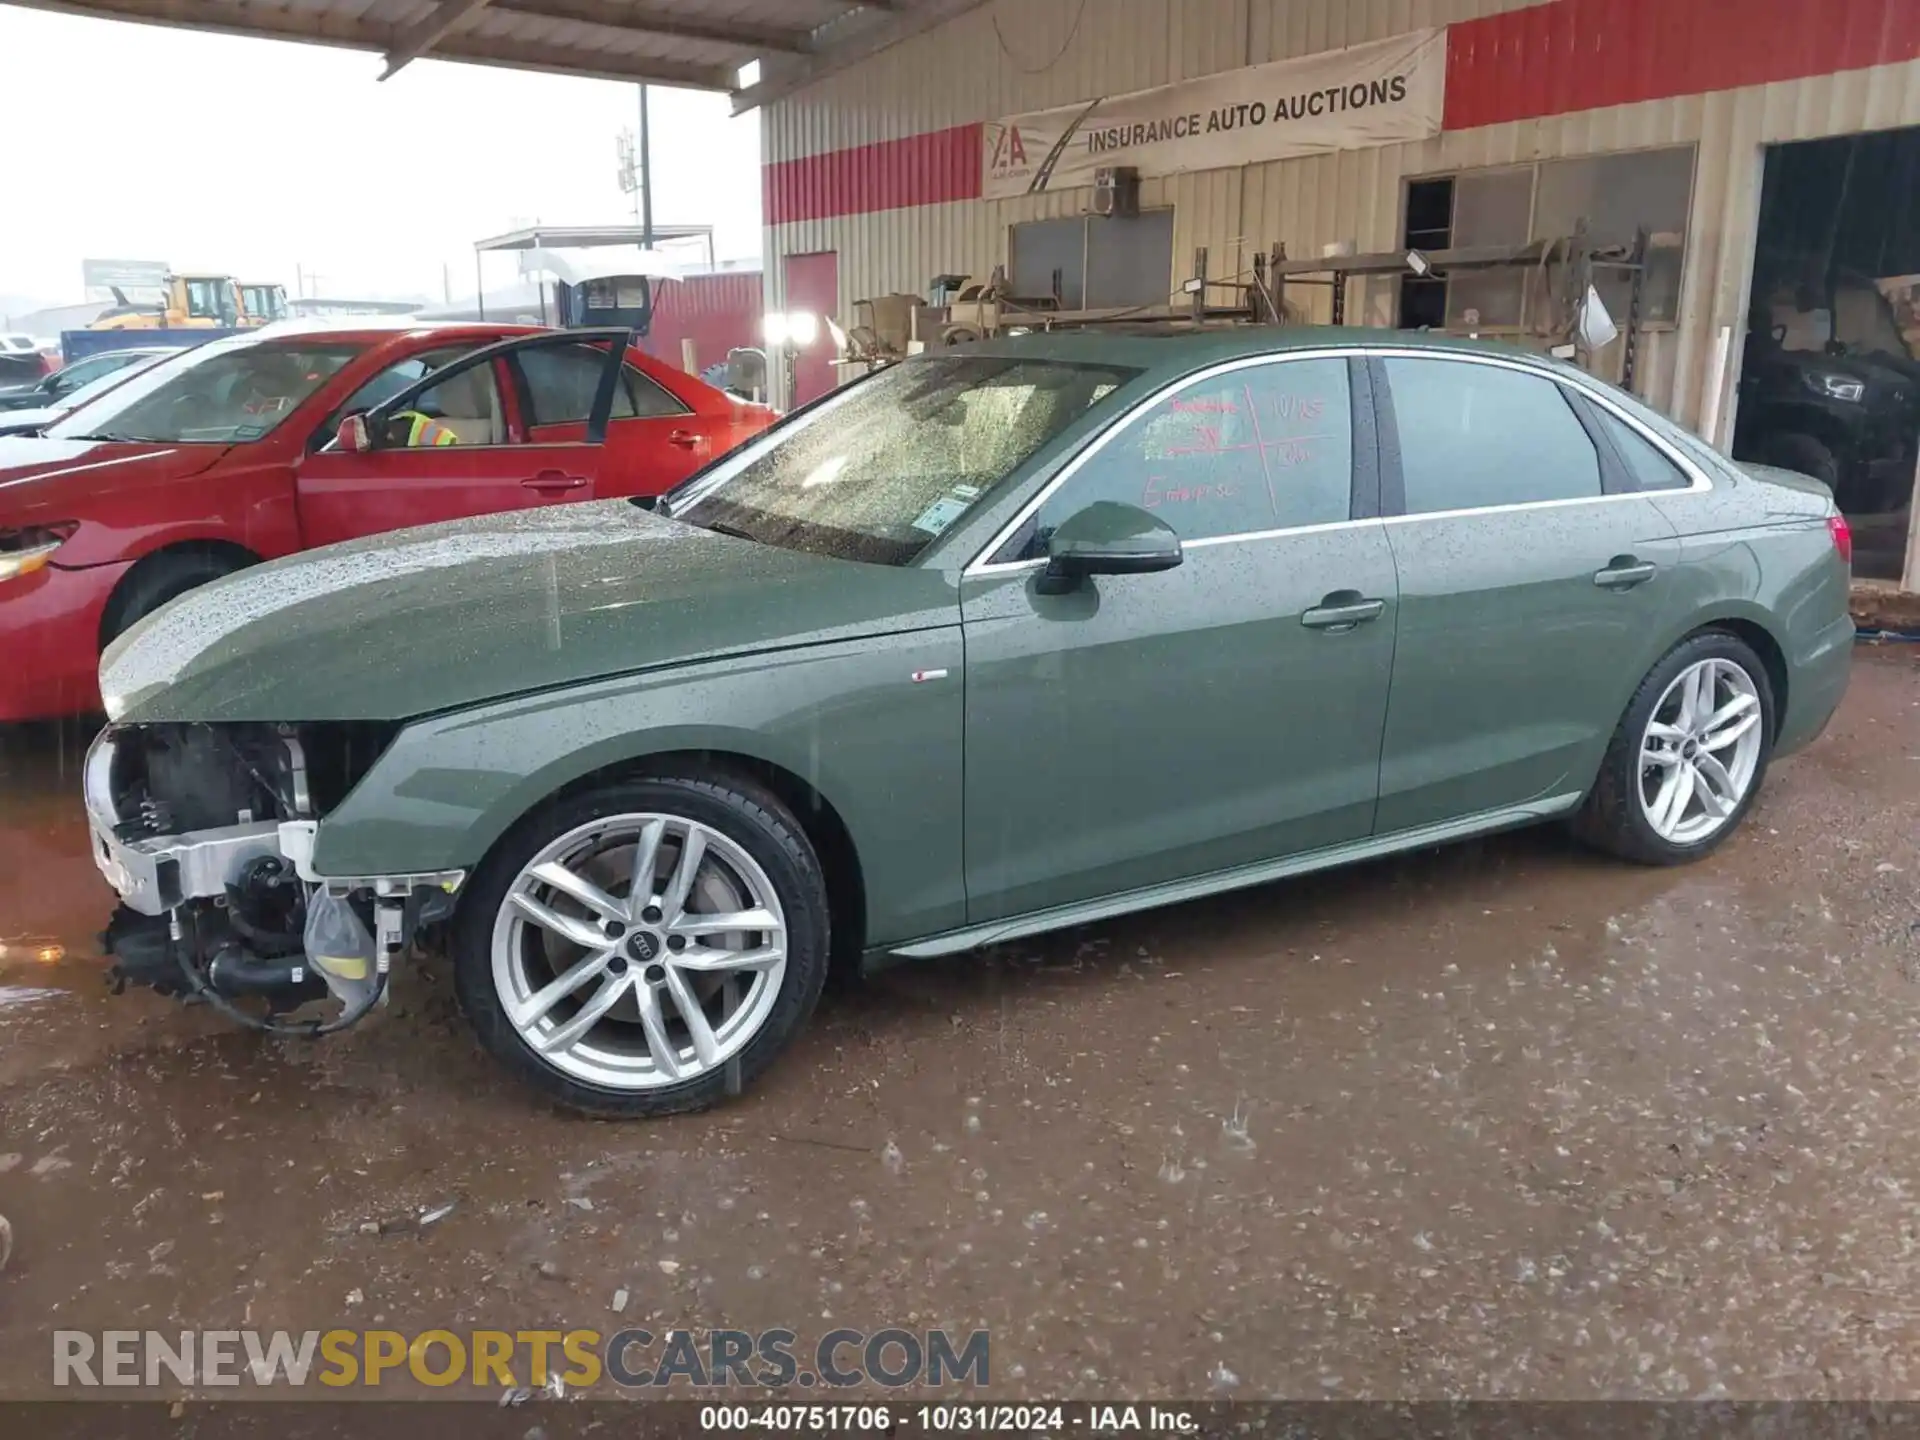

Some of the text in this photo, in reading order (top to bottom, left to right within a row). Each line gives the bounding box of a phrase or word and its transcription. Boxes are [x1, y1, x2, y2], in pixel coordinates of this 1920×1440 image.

[1089, 75, 1406, 152] INSURANCE AUTO AUCTIONS
